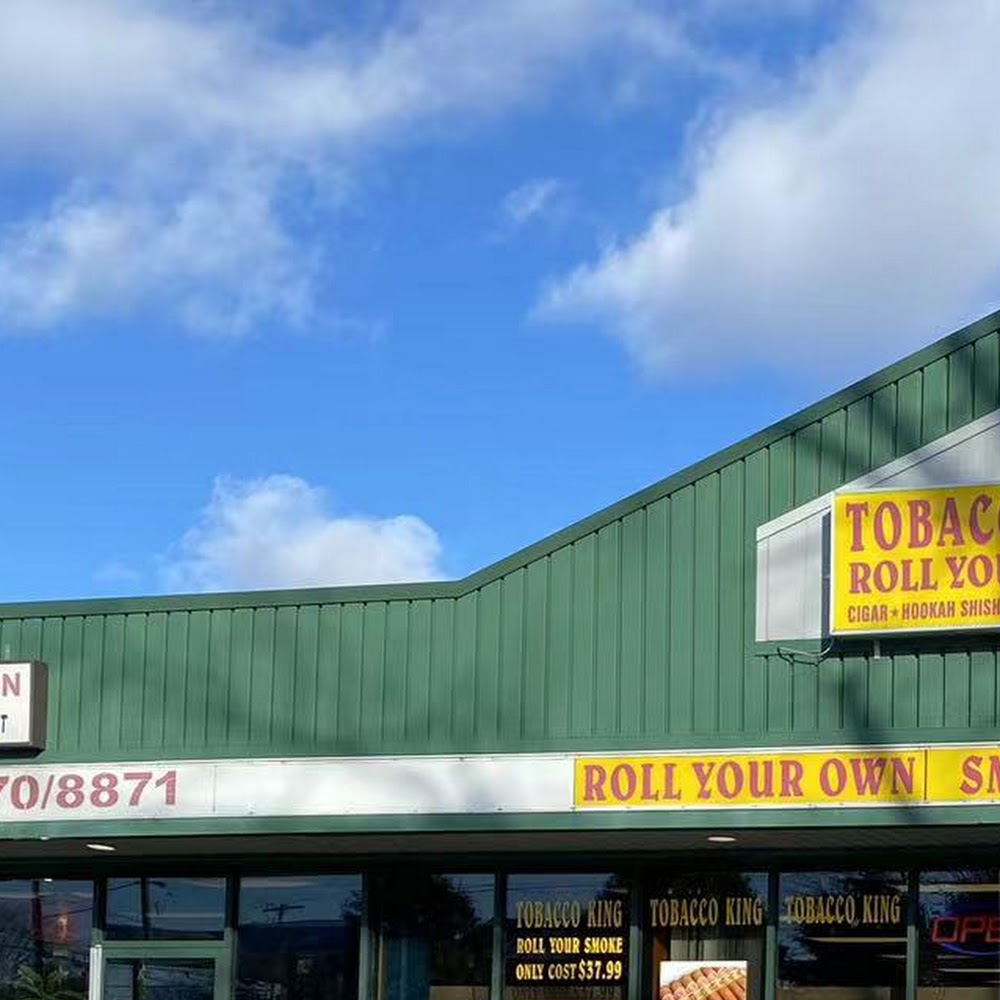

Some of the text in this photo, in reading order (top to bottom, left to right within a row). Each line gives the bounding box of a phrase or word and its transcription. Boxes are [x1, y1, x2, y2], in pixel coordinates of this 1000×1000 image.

[849, 557, 938, 594] ROLL
[847, 602, 888, 623] CIGAR
[901, 600, 956, 621] HOOKAH
[583, 763, 682, 802] ROLL
[692, 760, 804, 799] YOUR
[819, 756, 917, 797] OWN
[516, 900, 622, 928] TOBACCO KING
[650, 898, 763, 927] TOBACCO KING
[787, 895, 901, 924] TOBACCO KING
[516, 937, 623, 954] ROLL YOUR SMOKE
[516, 959, 622, 981] ONLY COST $37.99
